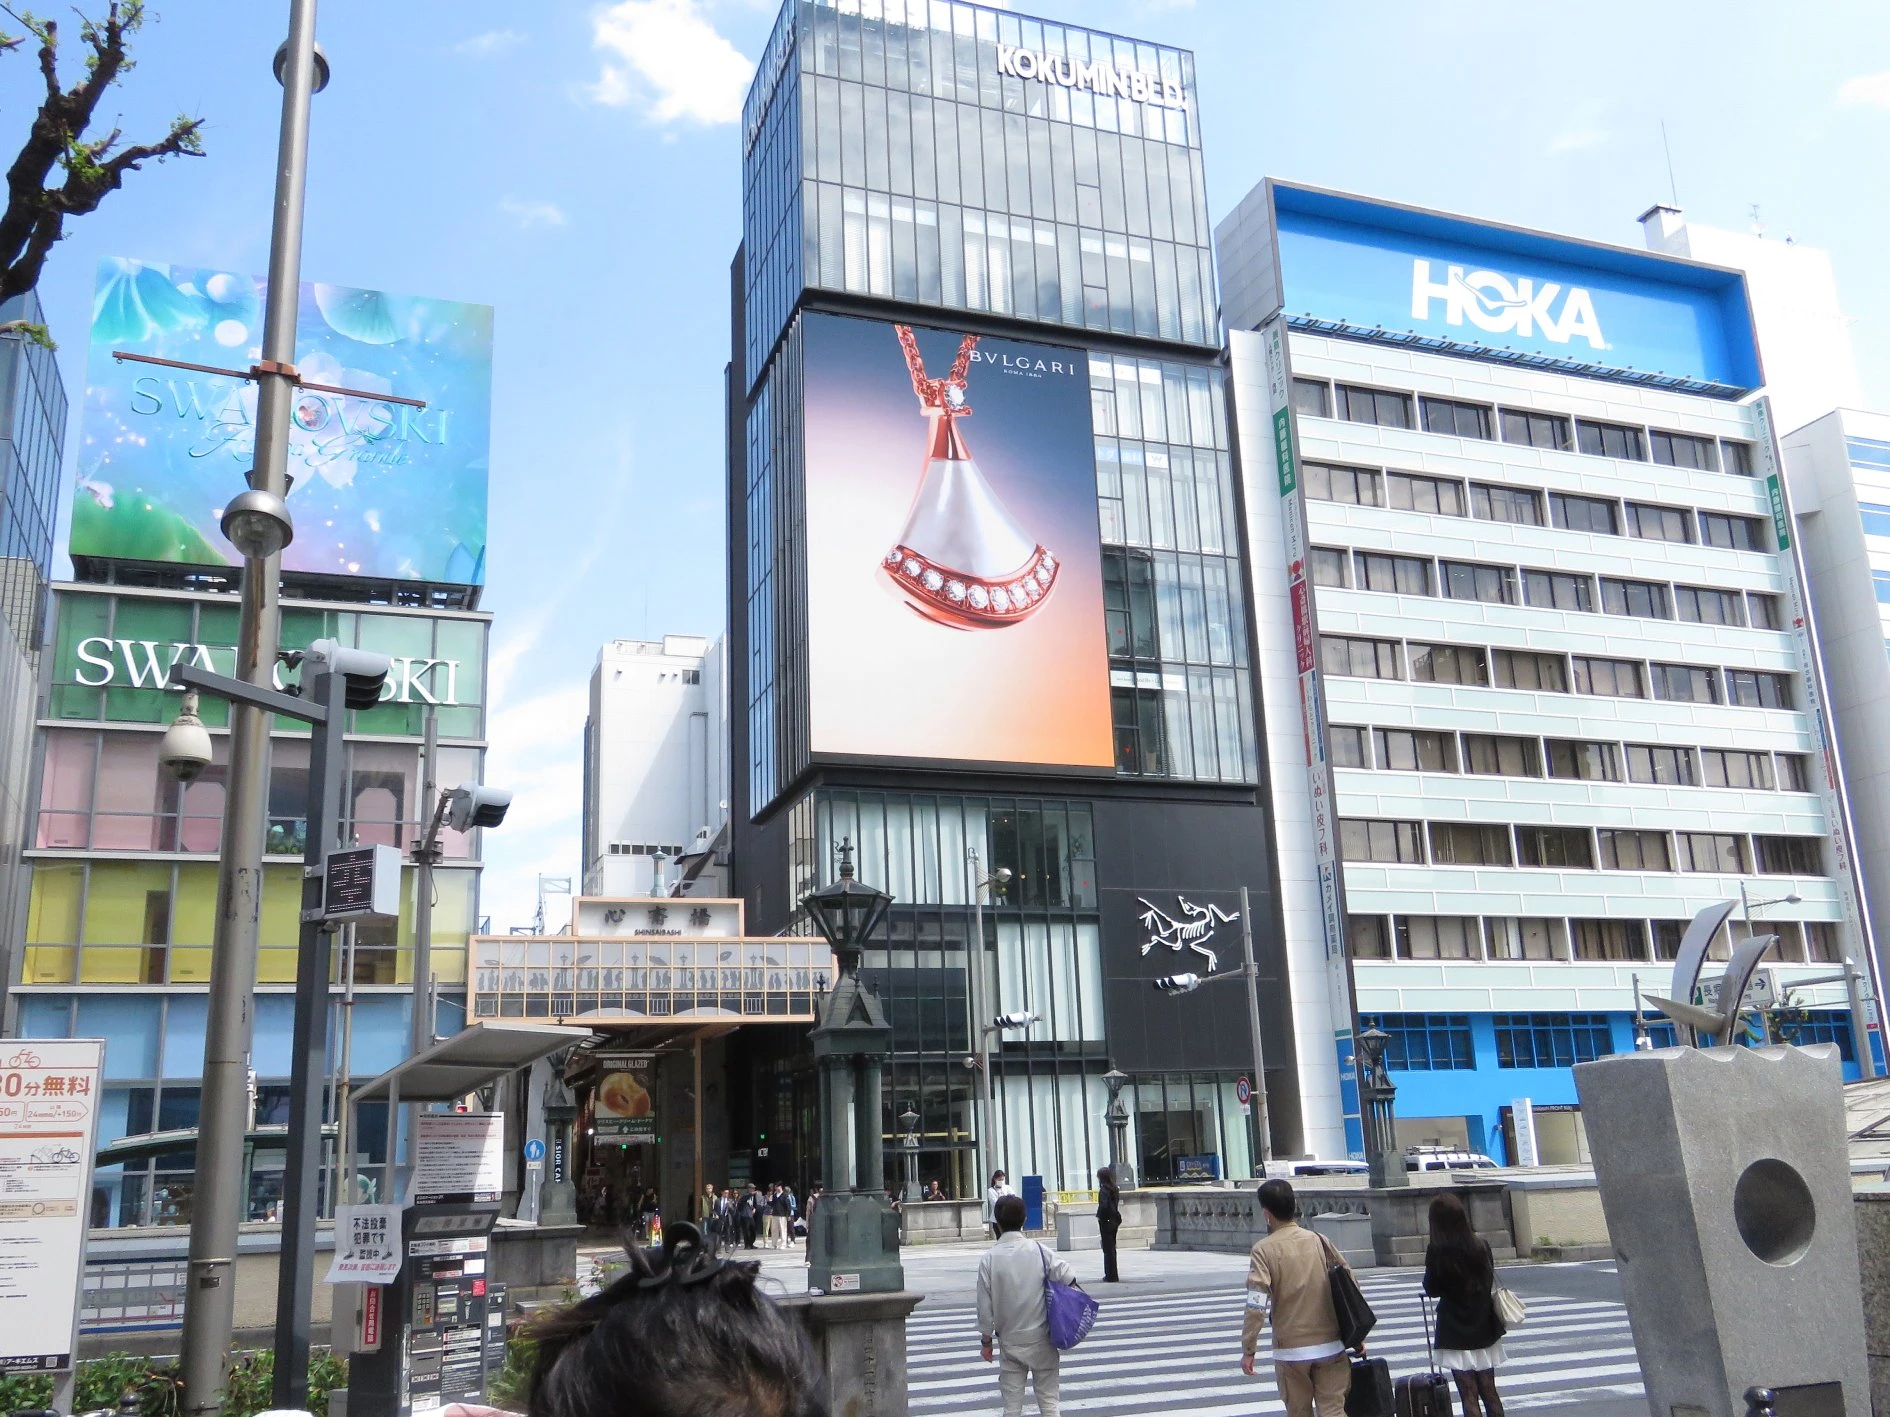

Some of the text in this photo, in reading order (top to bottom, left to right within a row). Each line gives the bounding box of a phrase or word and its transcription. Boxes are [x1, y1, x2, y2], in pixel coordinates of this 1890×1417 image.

[996, 43, 1129, 99] KOKUMIN
[1411, 258, 1607, 350] HOKA
[970, 350, 1075, 376] BVLGARI
[1003, 369, 1023, 377] ROMA
[131, 376, 449, 446] SWAOVSKI
[1312, 773, 1328, 857] いぬい皮フ科
[0, 1072, 91, 1098] 0分無料
[353, 1217, 387, 1230] 不法投棄
[353, 1232, 387, 1245] 犯罪です
